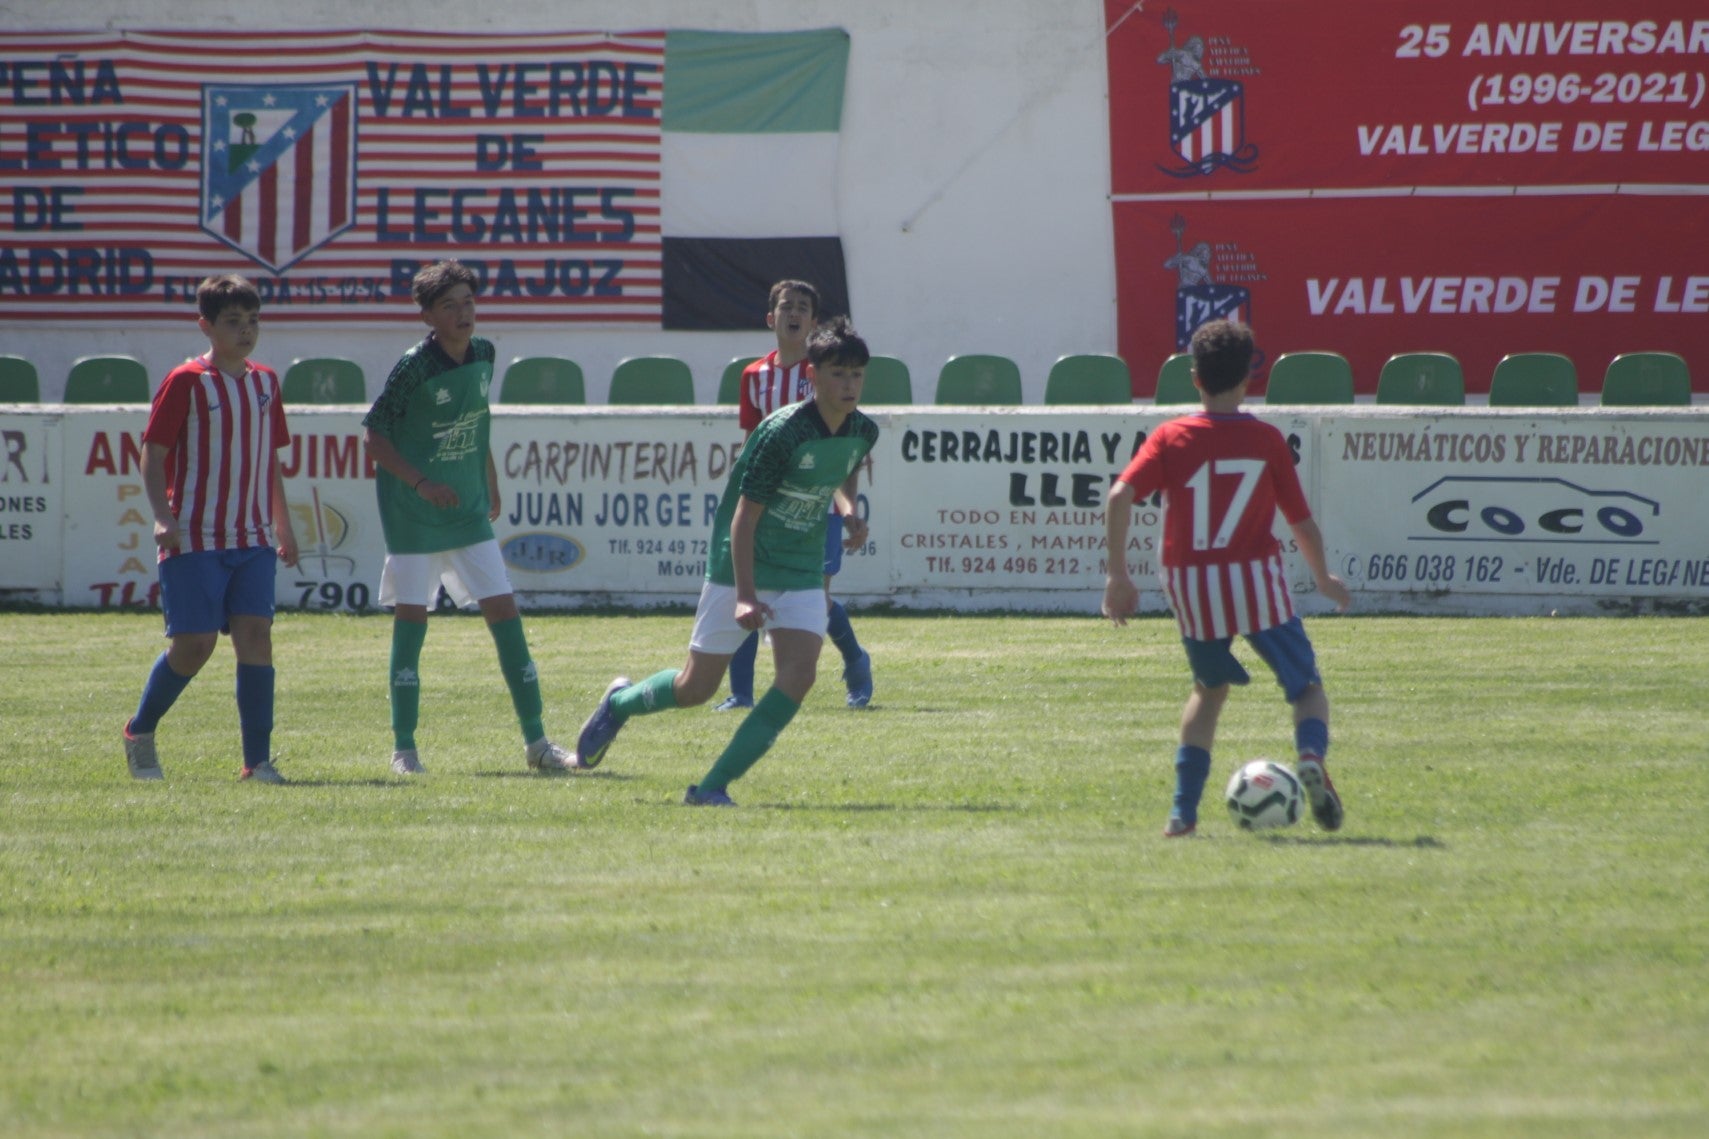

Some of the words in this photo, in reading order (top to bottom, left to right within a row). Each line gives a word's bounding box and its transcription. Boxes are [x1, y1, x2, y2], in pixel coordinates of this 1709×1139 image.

[1396, 25, 1451, 58] 25
[0, 52, 124, 106] EÑA
[366, 61, 657, 118] VALVERDE
[1467, 72, 1706, 111] (1996-2021)
[475, 133, 545, 172] DE
[1357, 123, 1563, 155] VALVERDE
[1573, 121, 1627, 152] DE
[13, 185, 85, 232] DE
[376, 187, 635, 243] LEGANES
[391, 258, 623, 297] BDAJOZ
[1306, 276, 1561, 315] VALVERDE
[1573, 275, 1641, 313] DE
[505, 440, 698, 487] CARPINTERIA
[901, 429, 1093, 464] CERRAJERIA
[1101, 432, 1121, 464] Y
[1341, 426, 1507, 464] NEUMÁTICOS
[1513, 435, 1531, 463] Y
[509, 492, 583, 527] JUAN
[594, 492, 692, 527] JORGE
[937, 510, 999, 525] TODO
[1010, 510, 1035, 525] EN
[1045, 510, 1158, 526] ALUMIO
[1185, 458, 1268, 551] 17
[637, 539, 662, 555] 924
[668, 539, 686, 555] 49
[900, 534, 1008, 549] CRISTALES
[1031, 536, 1154, 551] MAMPAAS
[962, 556, 996, 574] 924
[1003, 556, 1037, 574] 496
[1045, 557, 1079, 575] 212
[1367, 554, 1408, 582] 666
[1414, 555, 1456, 582] 038
[1465, 556, 1504, 583] 162
[1589, 558, 1621, 585] DE
